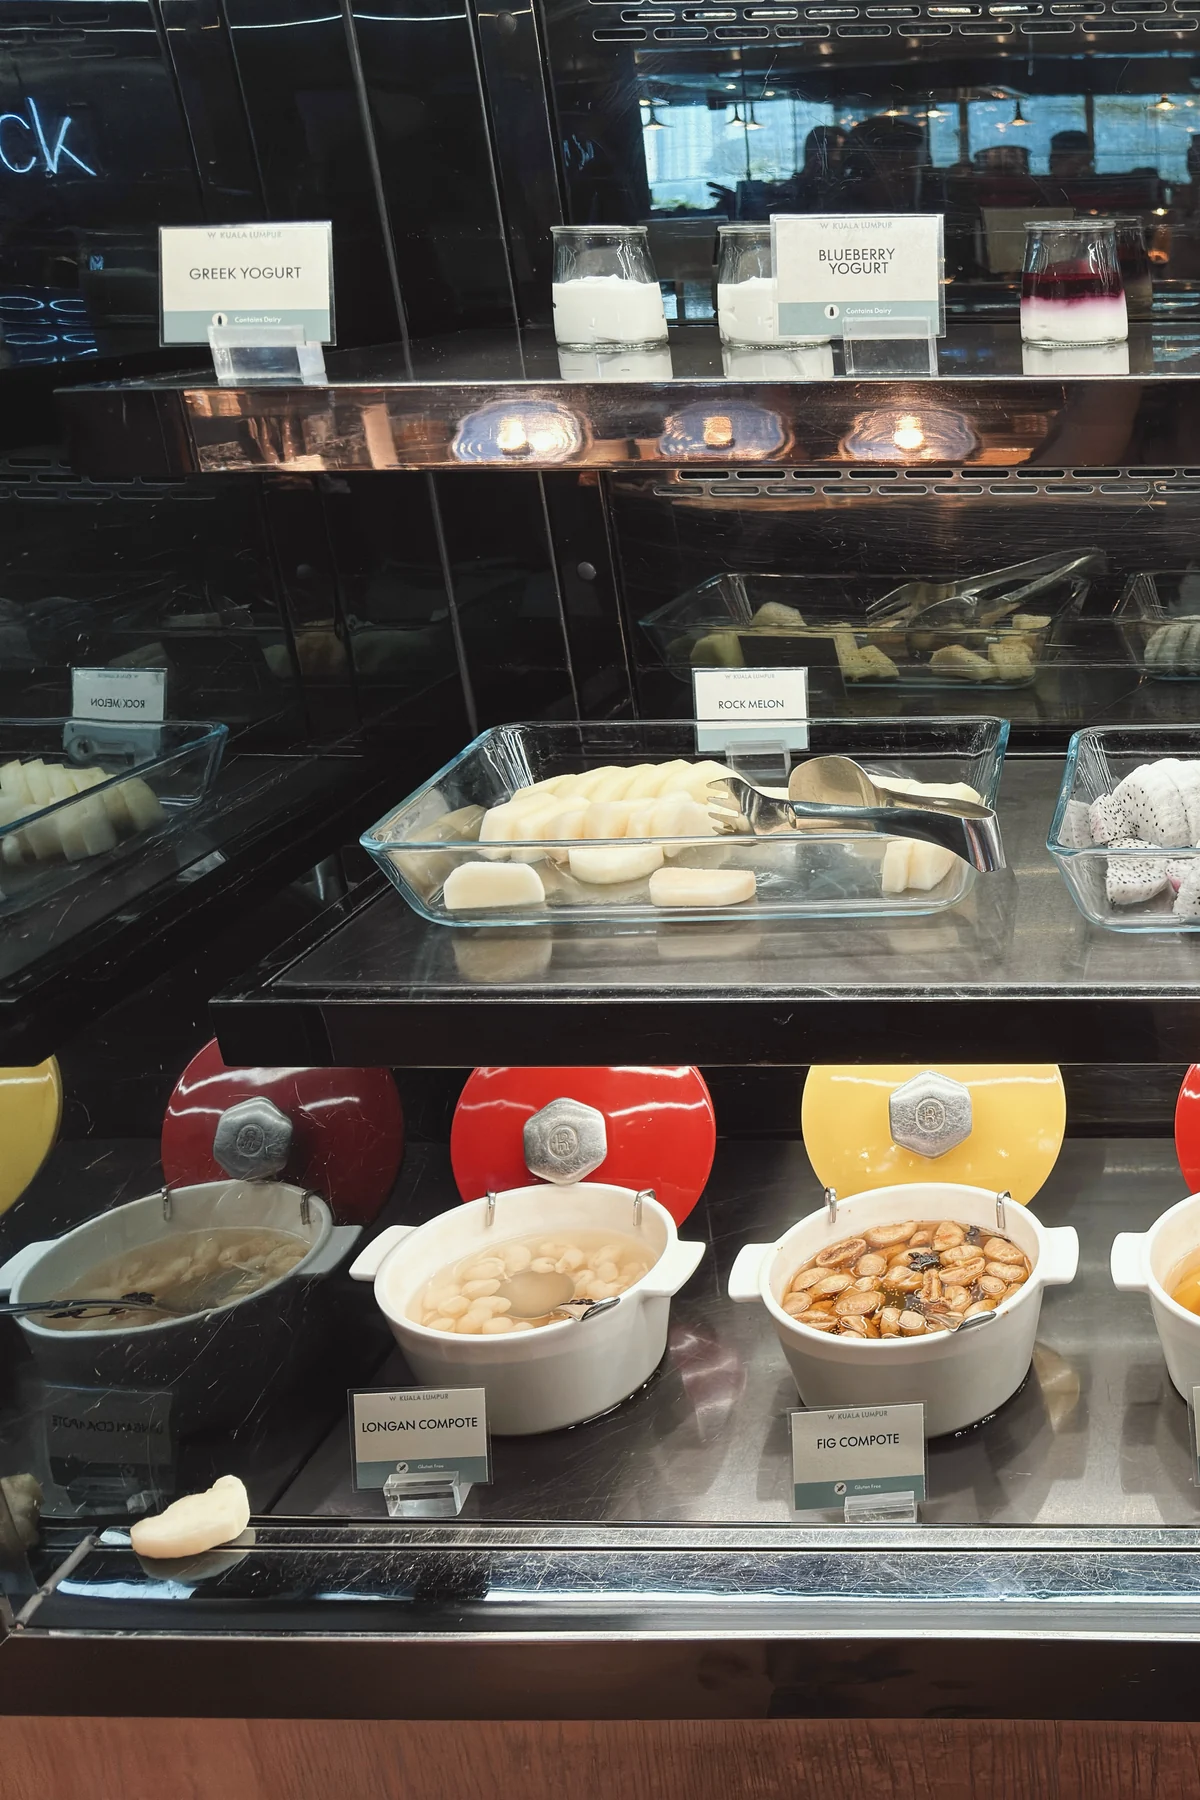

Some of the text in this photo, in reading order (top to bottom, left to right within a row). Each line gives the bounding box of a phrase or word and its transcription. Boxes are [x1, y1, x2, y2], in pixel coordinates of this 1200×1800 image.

[832, 222, 858, 230] KUALA
[220, 231, 247, 239] KUALA
[250, 230, 282, 238] LUMPUR
[818, 248, 895, 262] BLUEBERRY
[189, 266, 302, 280] GREEK YOGURT
[828, 262, 889, 274] YOGURT
[874, 307, 892, 315] Dairy
[264, 316, 282, 324] Dairy
[718, 699, 784, 710] ROCK MELON
[399, 1394, 421, 1402] KUALA
[837, 1412, 860, 1420] KUALA
[861, 1410, 888, 1418] LUMPUR
[362, 1417, 478, 1432] LONGAN COMPOTE
[817, 1433, 900, 1449] FIG COMPOTE
